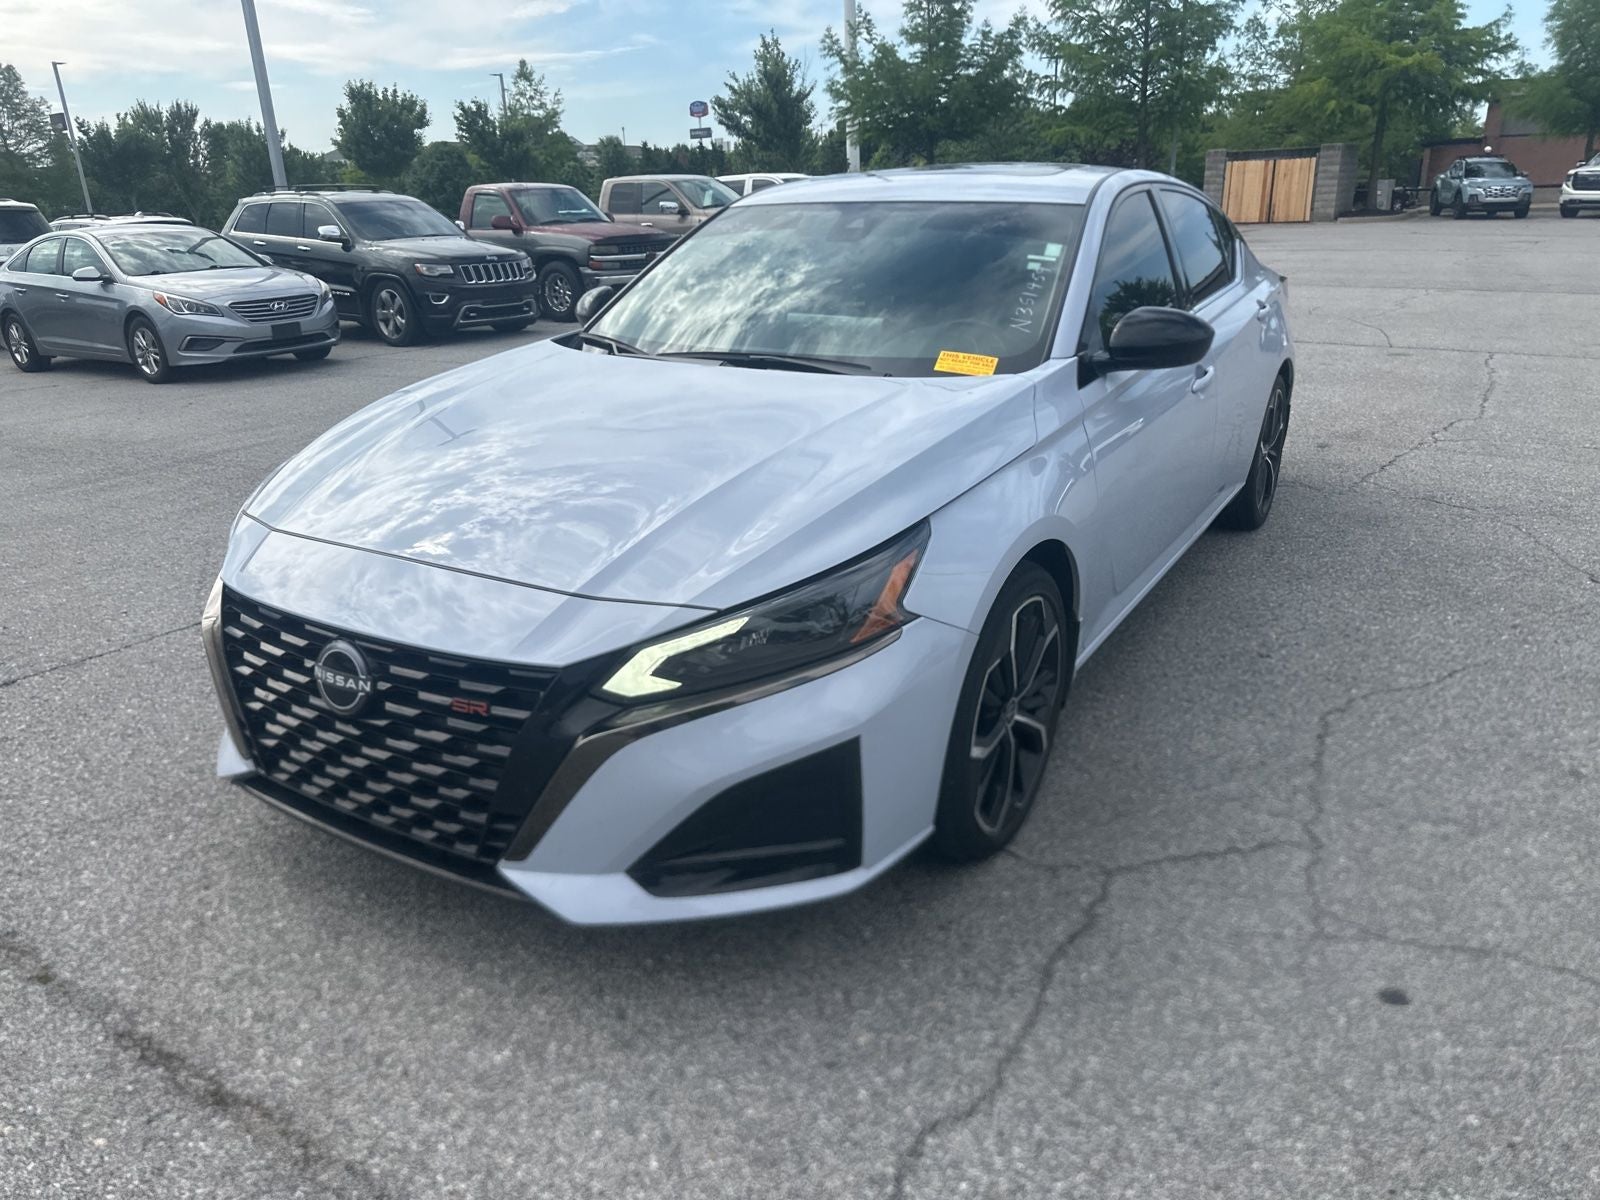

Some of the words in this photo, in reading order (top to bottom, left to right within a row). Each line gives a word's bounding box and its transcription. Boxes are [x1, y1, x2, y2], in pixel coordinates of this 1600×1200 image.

[962, 354, 996, 363] VEHICLE
[314, 666, 371, 692] NISSAN
[450, 697, 489, 716] SR
